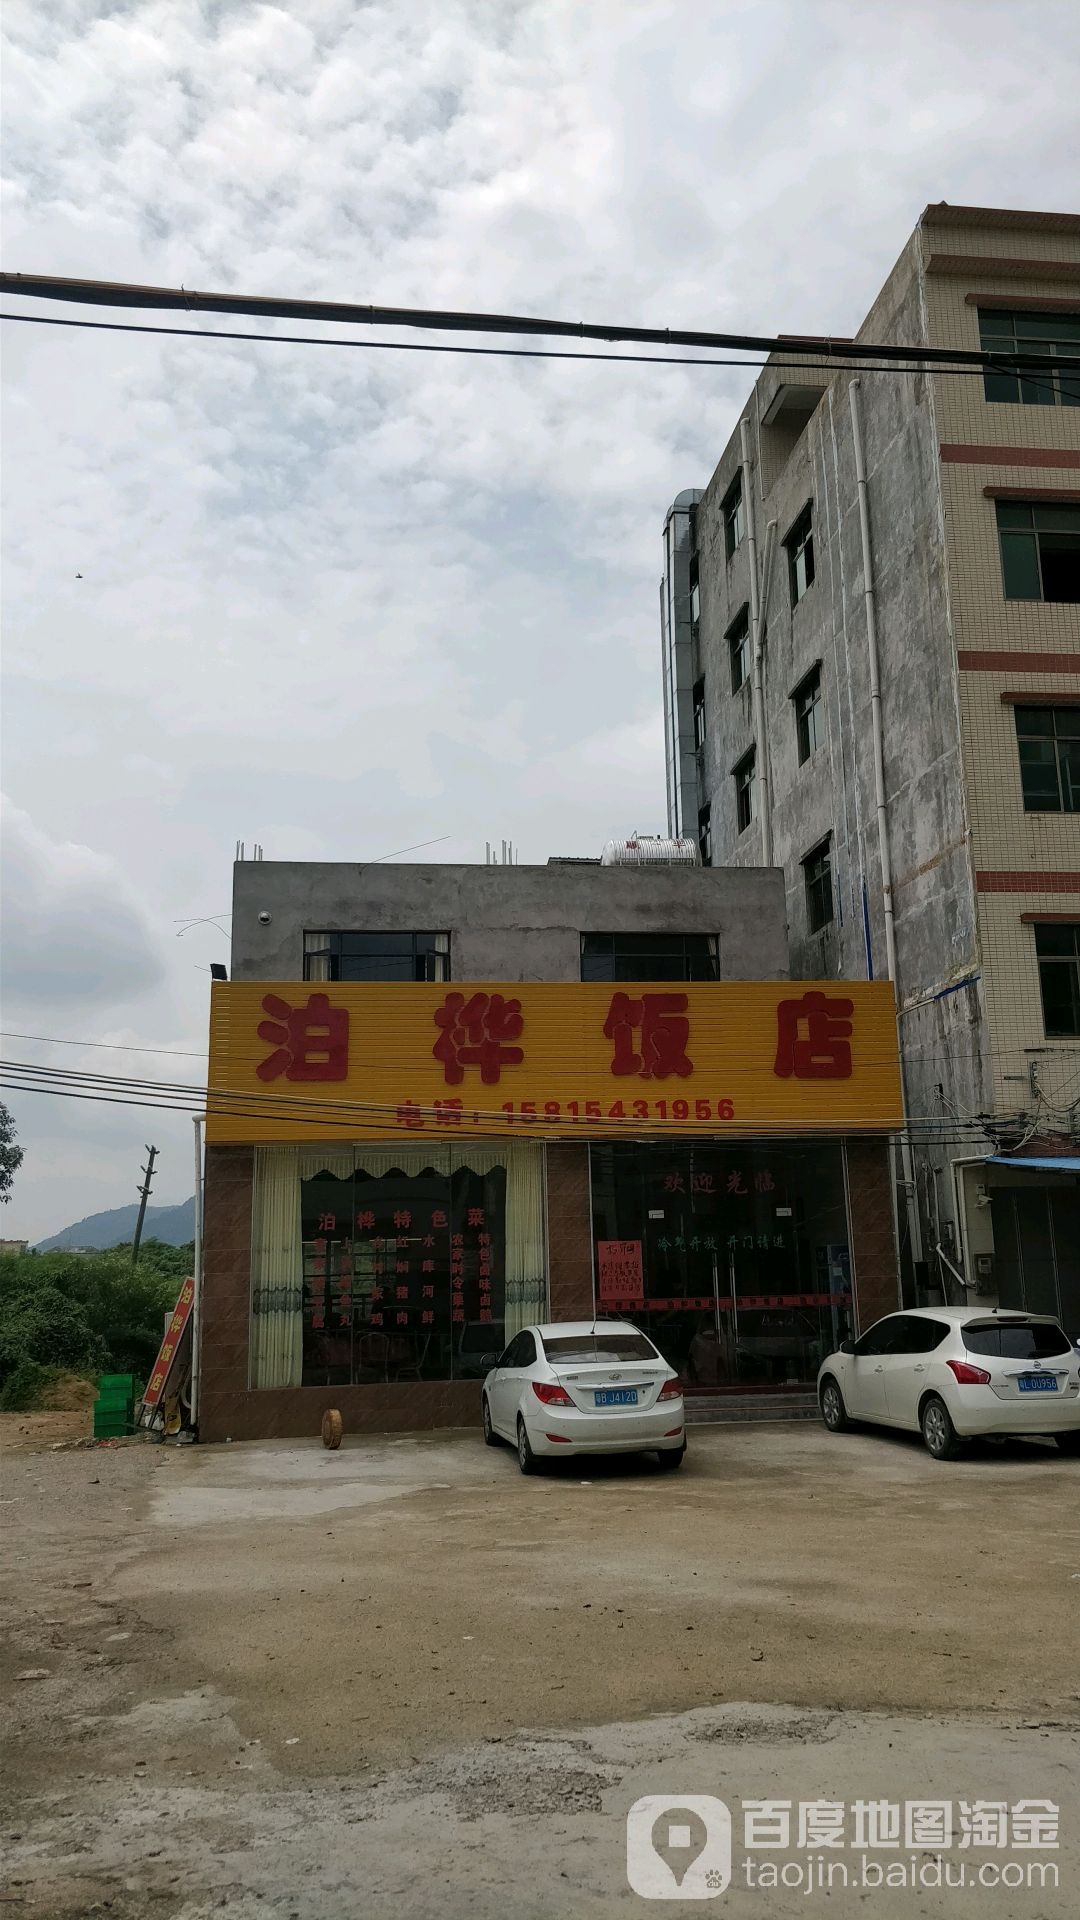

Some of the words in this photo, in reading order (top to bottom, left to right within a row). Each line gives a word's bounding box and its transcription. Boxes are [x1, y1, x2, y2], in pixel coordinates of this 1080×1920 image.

[256, 991, 854, 1085] 泊桦饭店
[502, 1099, 735, 1124] 15815431956
[663, 1170, 776, 1194] 欢迎光临
[318, 1207, 485, 1231] 泊桦特色菜
